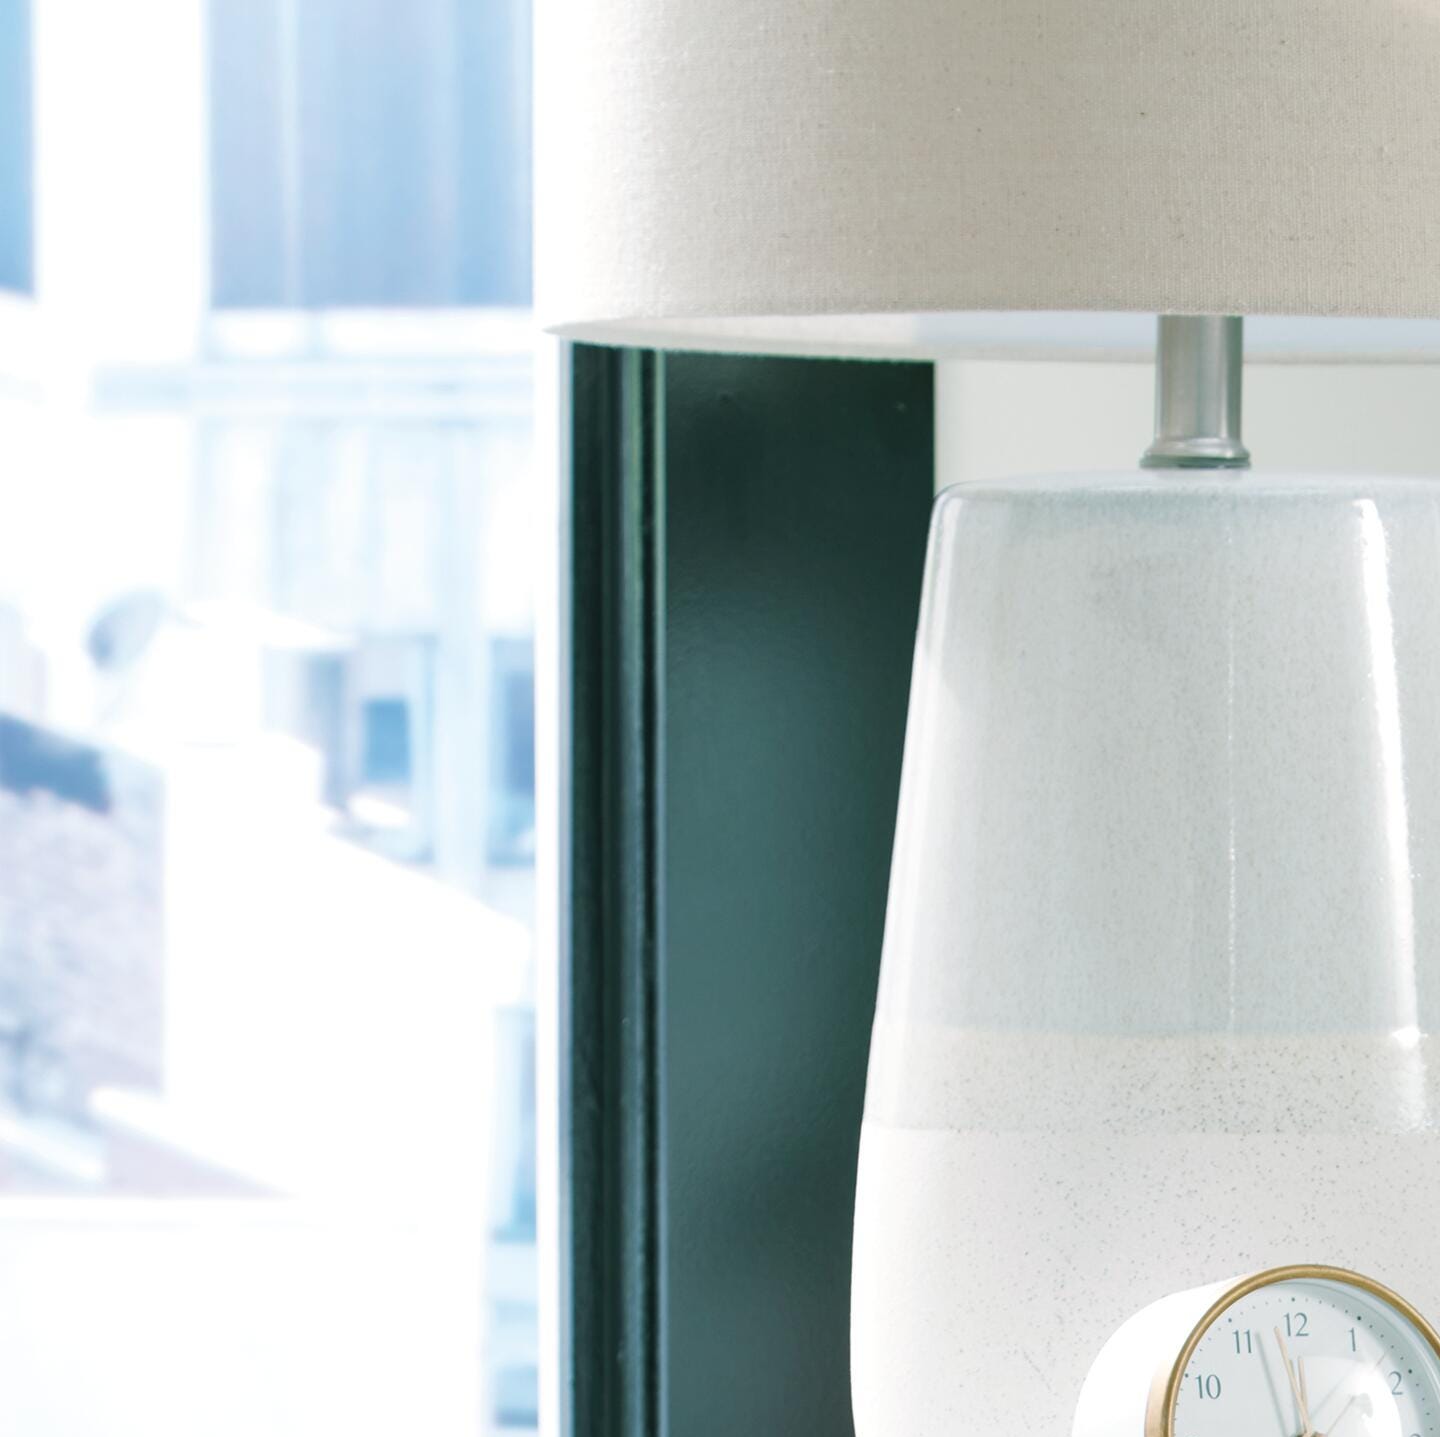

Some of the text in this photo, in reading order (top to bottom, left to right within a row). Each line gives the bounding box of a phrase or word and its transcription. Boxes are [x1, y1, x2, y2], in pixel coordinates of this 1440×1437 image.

[1283, 1312, 1309, 1337] 12
[1232, 1330, 1253, 1354] 11
[1348, 1327, 1357, 1352] 1
[1195, 1374, 1222, 1399] 10
[1388, 1371, 1403, 1395] 2
